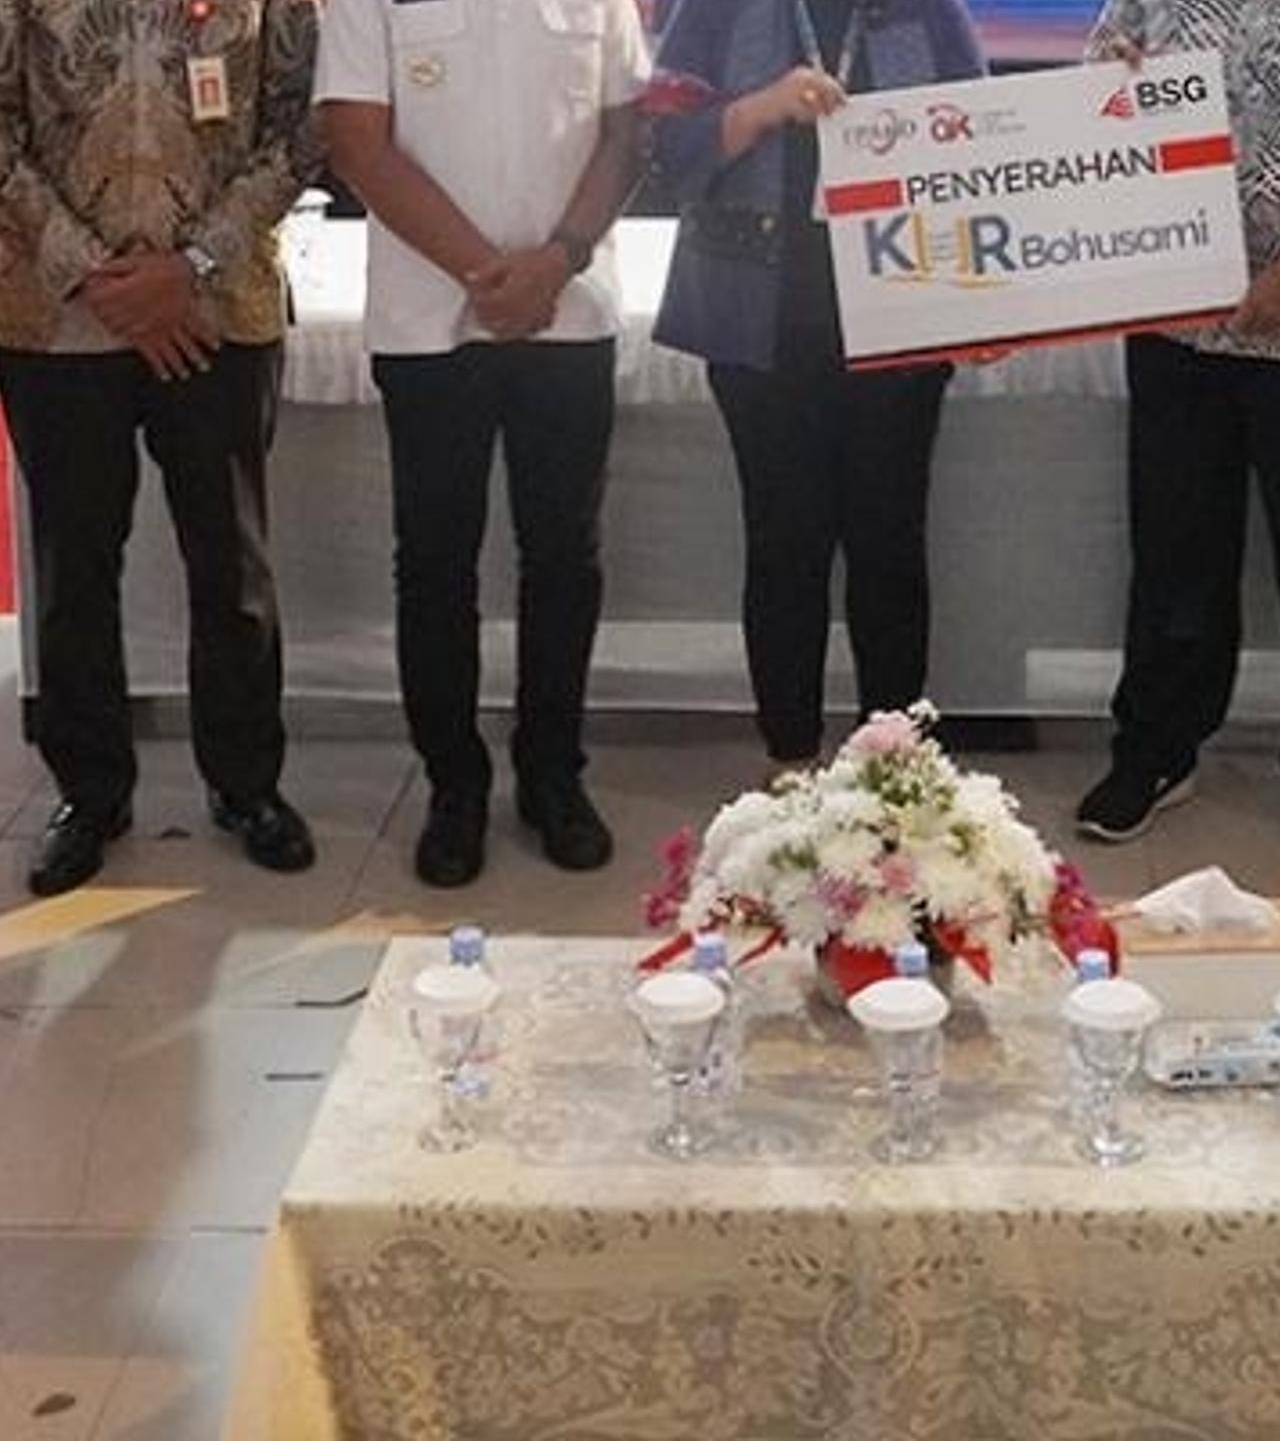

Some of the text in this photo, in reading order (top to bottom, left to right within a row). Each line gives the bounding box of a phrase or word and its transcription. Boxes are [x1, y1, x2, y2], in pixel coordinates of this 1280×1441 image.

[1134, 74, 1209, 110] BSG
[904, 145, 1159, 207] PENYERAHAN
[1020, 208, 1210, 270] Bohusami
